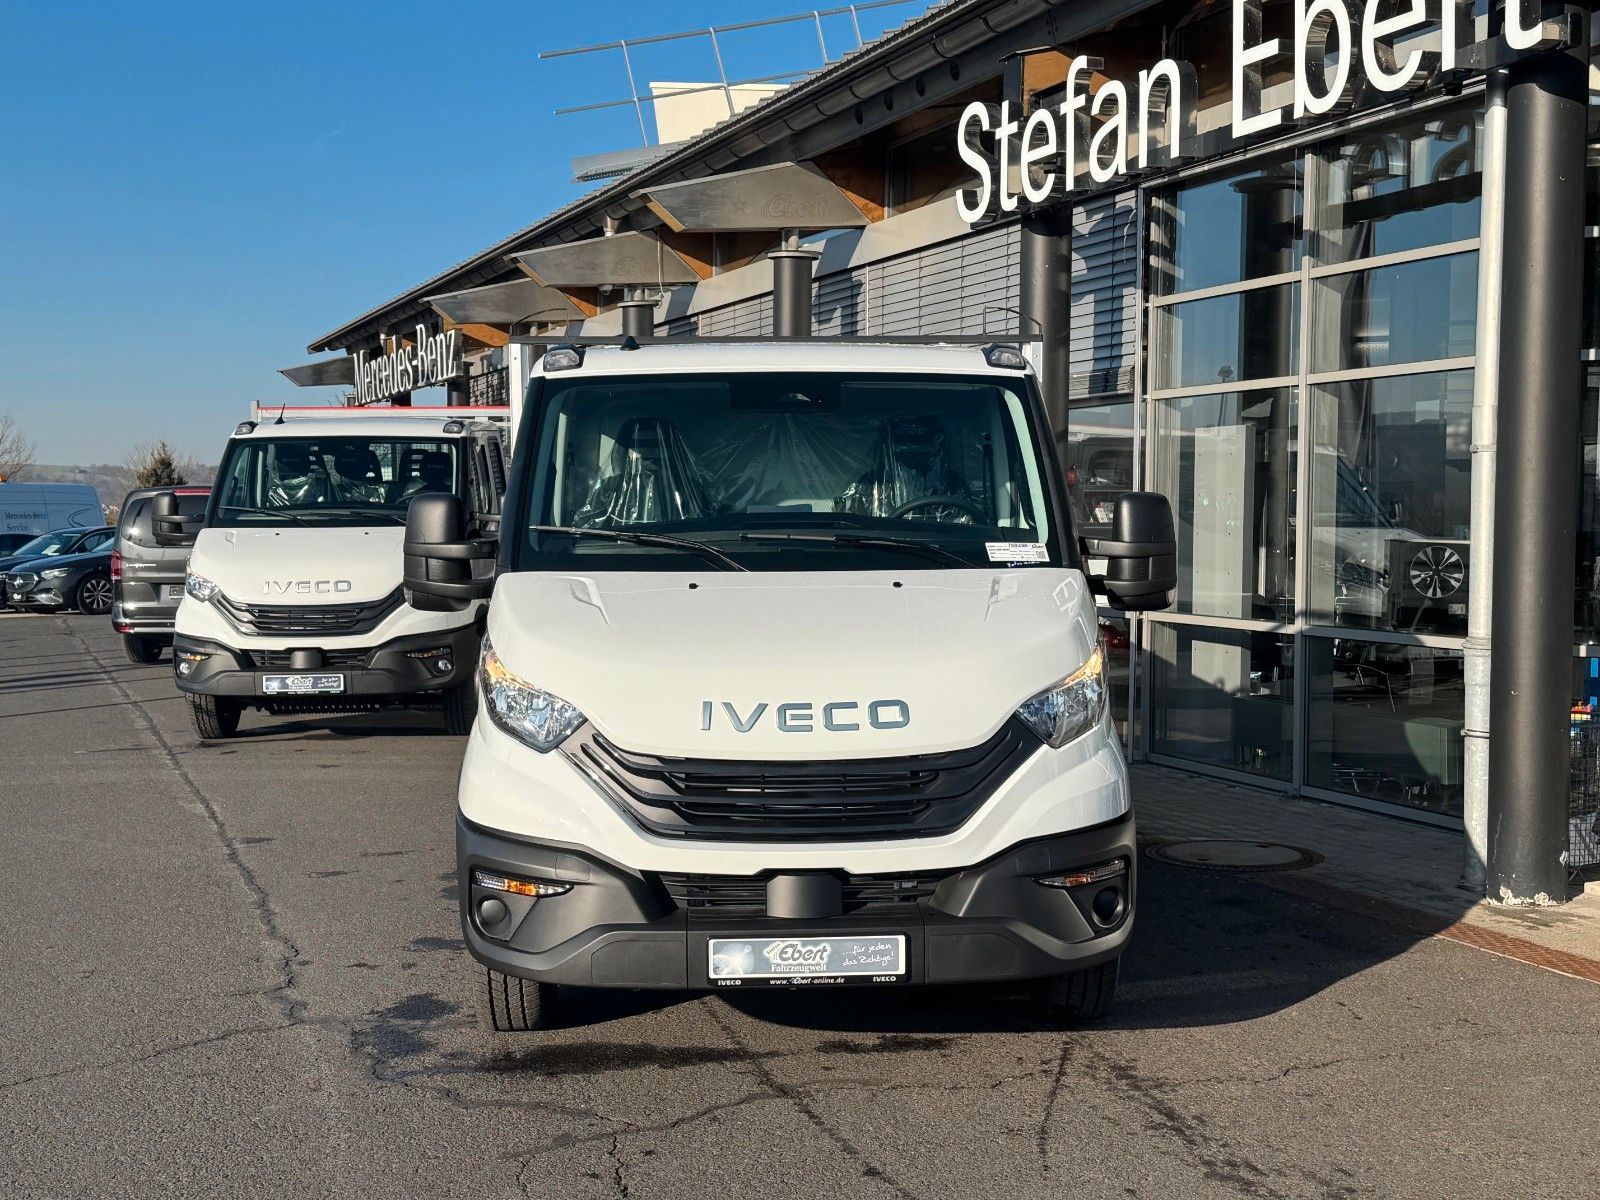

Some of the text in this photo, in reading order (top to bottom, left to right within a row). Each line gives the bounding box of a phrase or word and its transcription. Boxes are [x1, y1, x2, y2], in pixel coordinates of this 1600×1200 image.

[955, 55, 1181, 223] Stefan
[353, 324, 456, 405] Mercedes-Benz
[263, 580, 351, 594] IVECO
[701, 699, 910, 733] IVECO
[779, 943, 828, 961] Ebert
[868, 942, 892, 953] jeden
[771, 963, 827, 974] Fahrzeugwelt
[843, 958, 858, 966] das
[872, 975, 897, 983] IVECO
